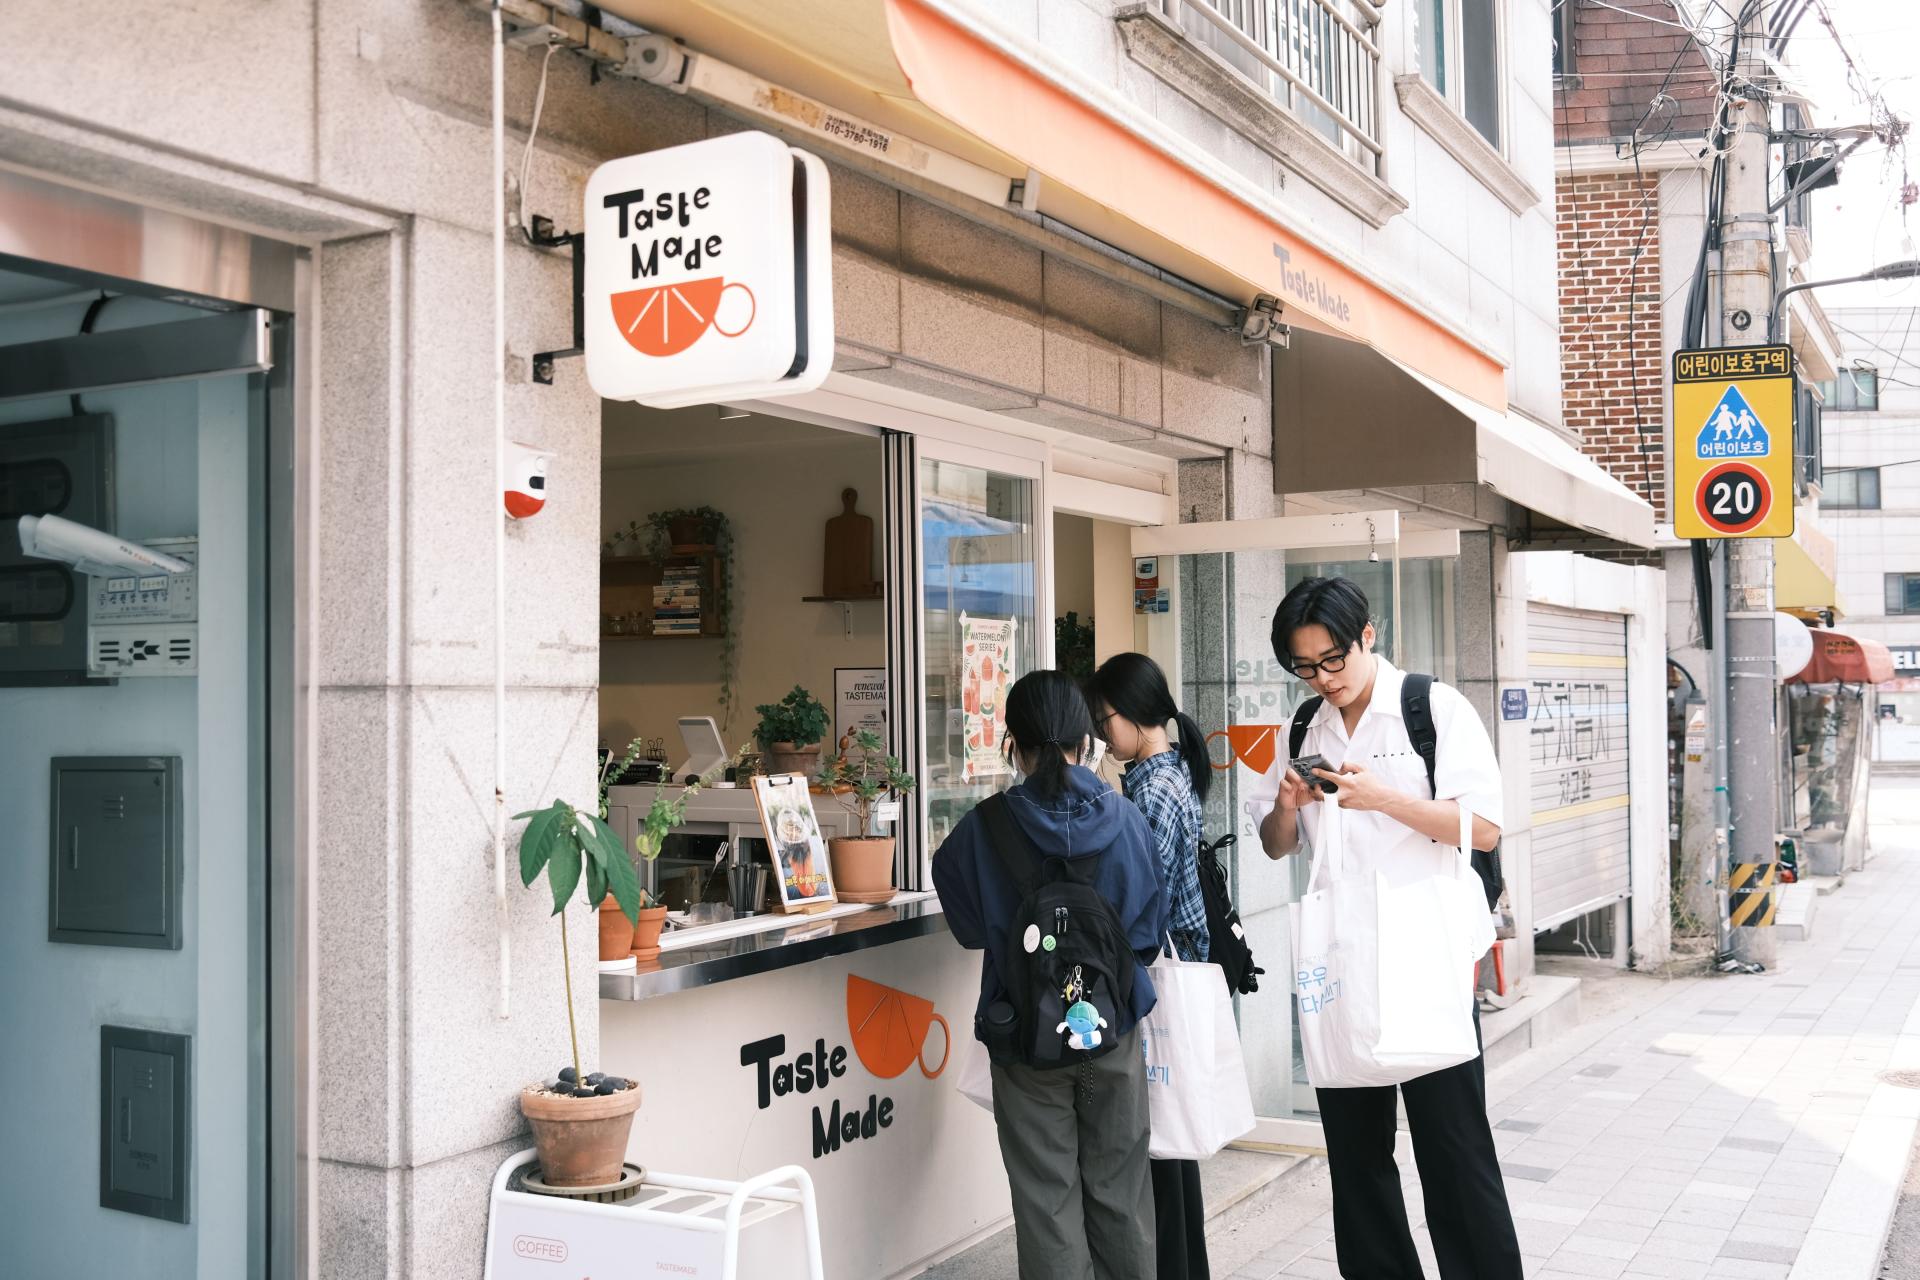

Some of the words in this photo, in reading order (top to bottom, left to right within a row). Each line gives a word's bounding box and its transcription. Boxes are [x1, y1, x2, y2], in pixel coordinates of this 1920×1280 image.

[603, 187, 711, 239] Taste
[631, 235, 723, 280] Made
[1679, 350, 1785, 377] 어린이보호구역
[1701, 440, 1765, 456] 어린이보호
[1712, 481, 1755, 515] 20
[978, 642, 996, 652] SERIES
[740, 1033, 848, 1110] Taste
[812, 1094, 894, 1159] Made
[516, 1239, 564, 1259] COFFEE
[655, 1261, 698, 1276] TASTEMADE
